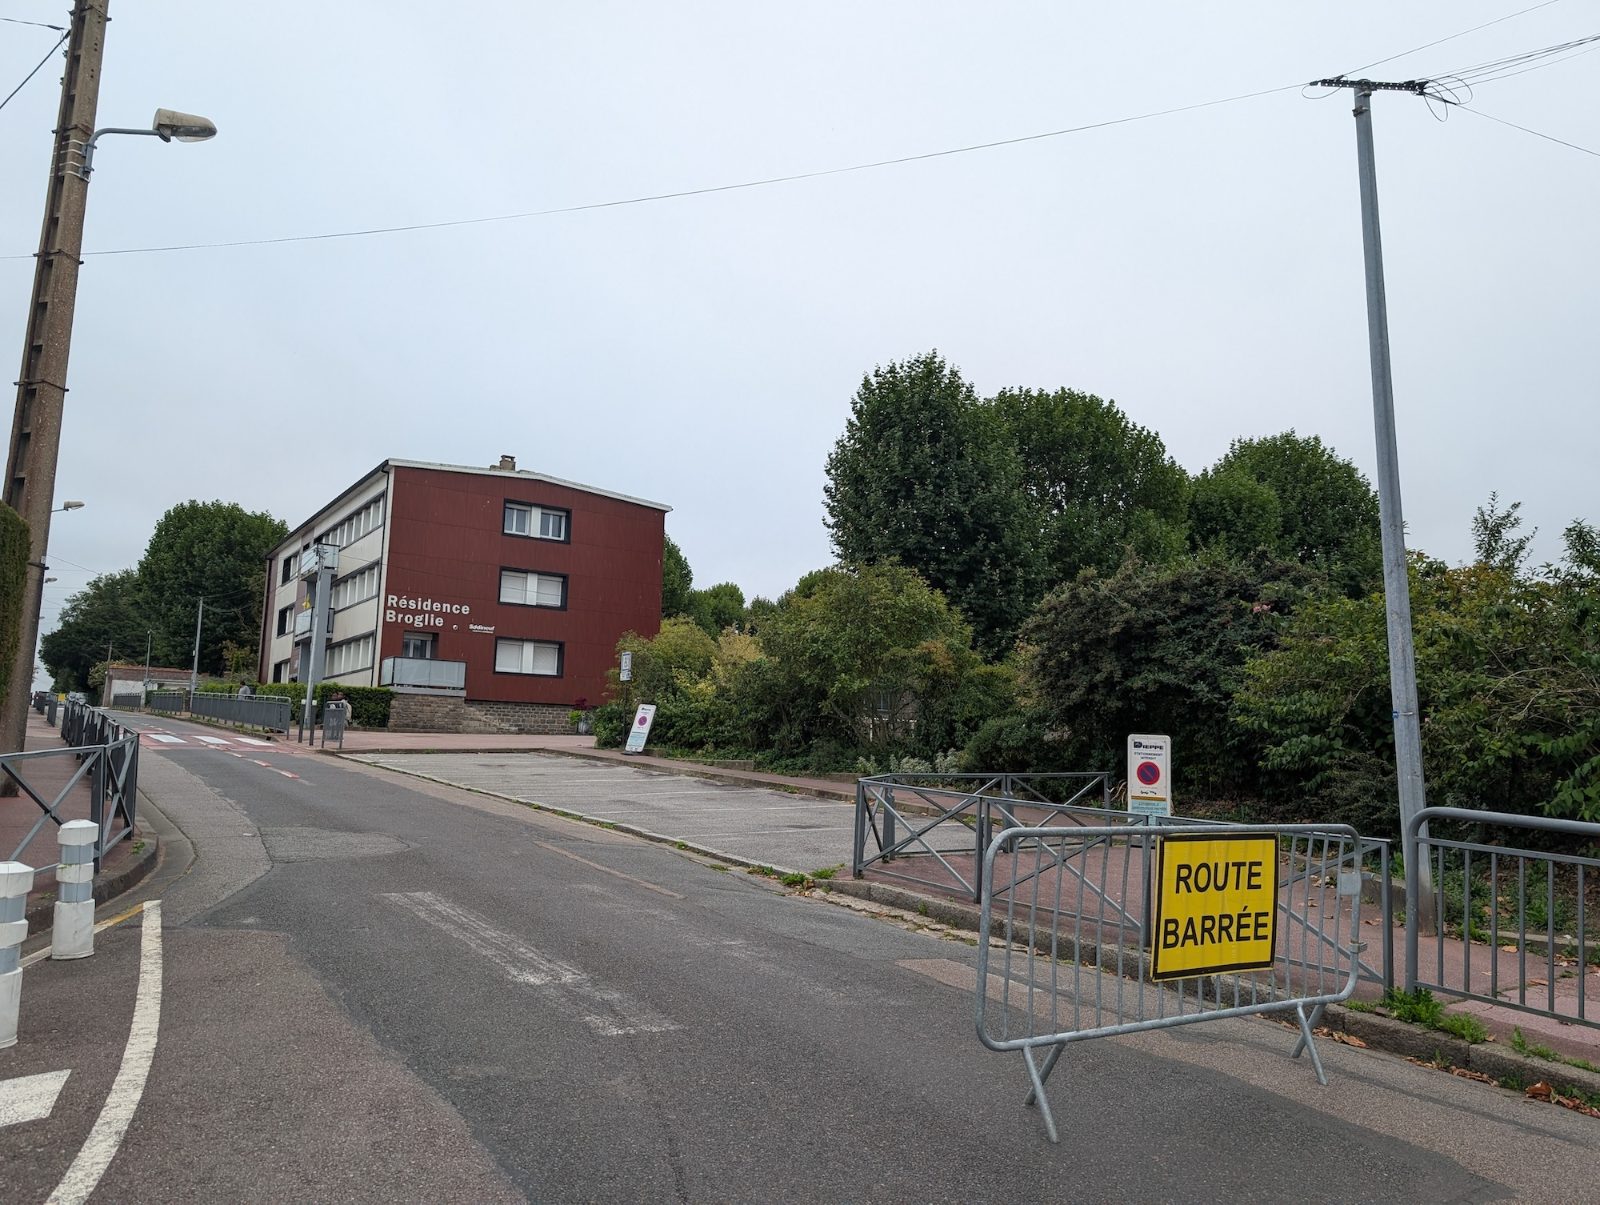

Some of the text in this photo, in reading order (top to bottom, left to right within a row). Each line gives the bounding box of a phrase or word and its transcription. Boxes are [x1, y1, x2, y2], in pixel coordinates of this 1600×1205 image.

[388, 595, 470, 615] Résidence
[386, 610, 444, 627] Broglie
[1176, 861, 1262, 894] ROUTE
[1162, 905, 1269, 950] BARRÉE
